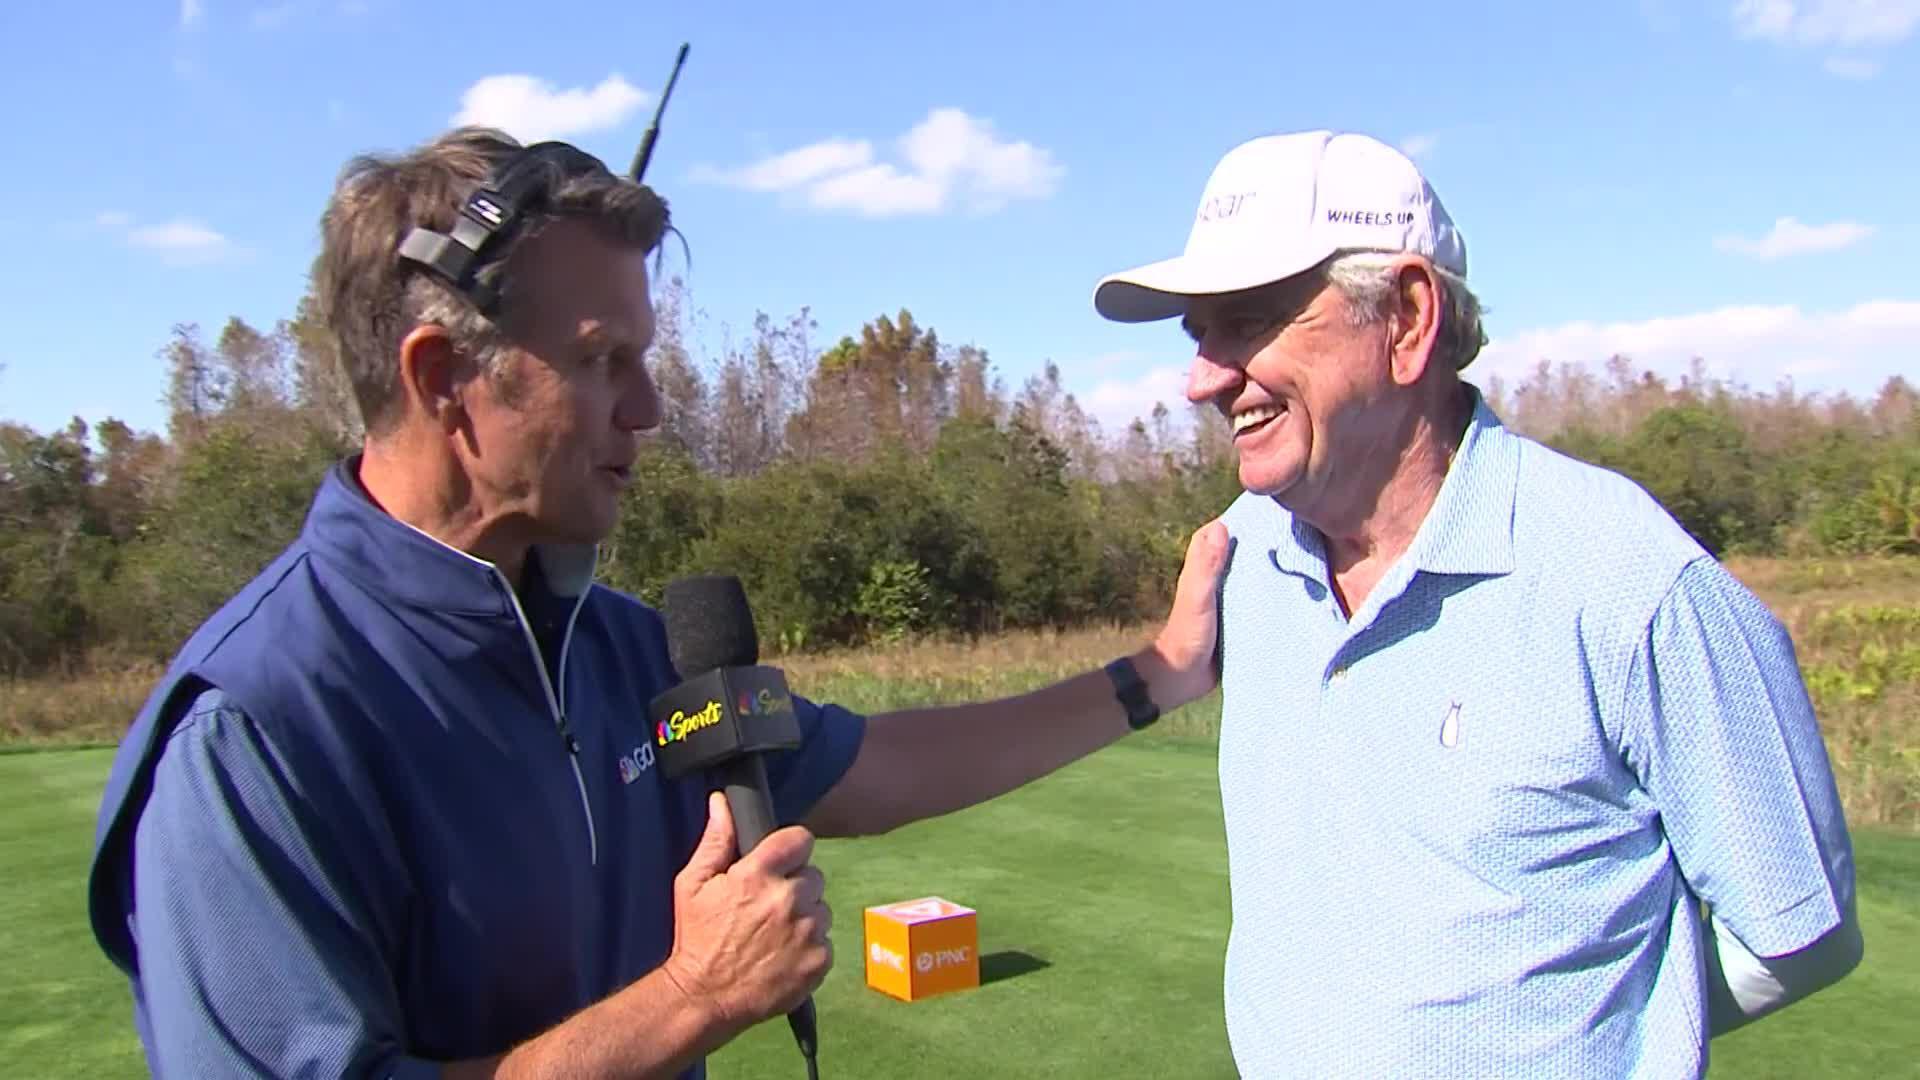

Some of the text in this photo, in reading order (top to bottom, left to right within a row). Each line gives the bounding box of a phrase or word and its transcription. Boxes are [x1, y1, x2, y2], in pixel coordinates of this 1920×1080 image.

[1328, 209, 1393, 226] WHEELS
[670, 701, 722, 742] Sports
[633, 740, 656, 771] GO
[935, 946, 971, 968] PNC
